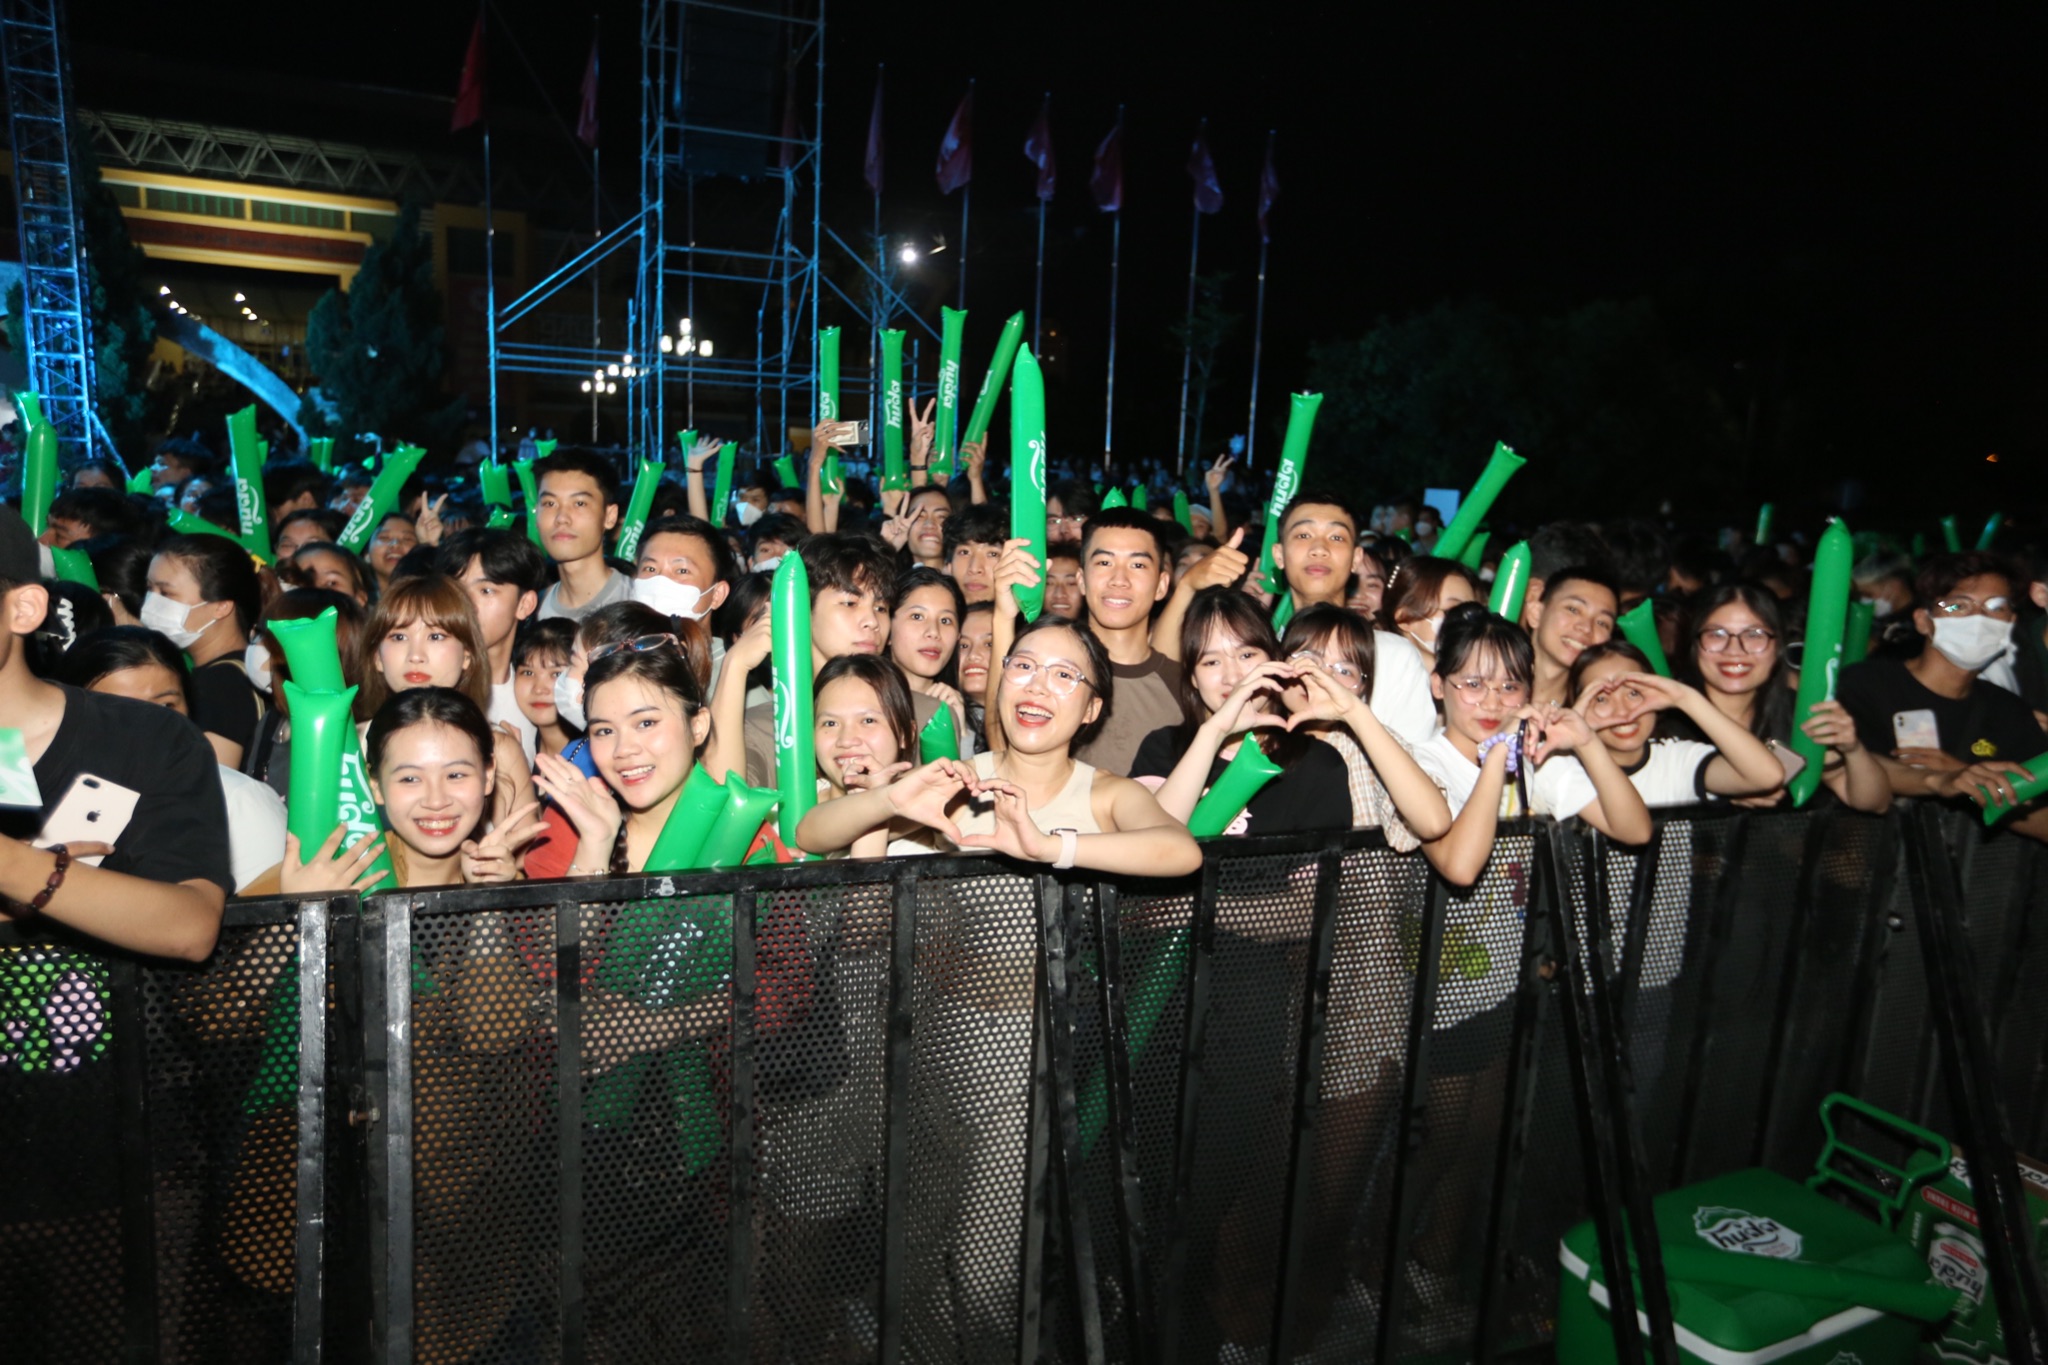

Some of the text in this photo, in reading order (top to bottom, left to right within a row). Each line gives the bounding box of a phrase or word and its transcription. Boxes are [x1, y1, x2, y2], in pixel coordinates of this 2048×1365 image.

[885, 380, 901, 429] huda
[943, 360, 959, 409] huda
[1269, 458, 1294, 518] huda
[1706, 1220, 1780, 1249] huda
